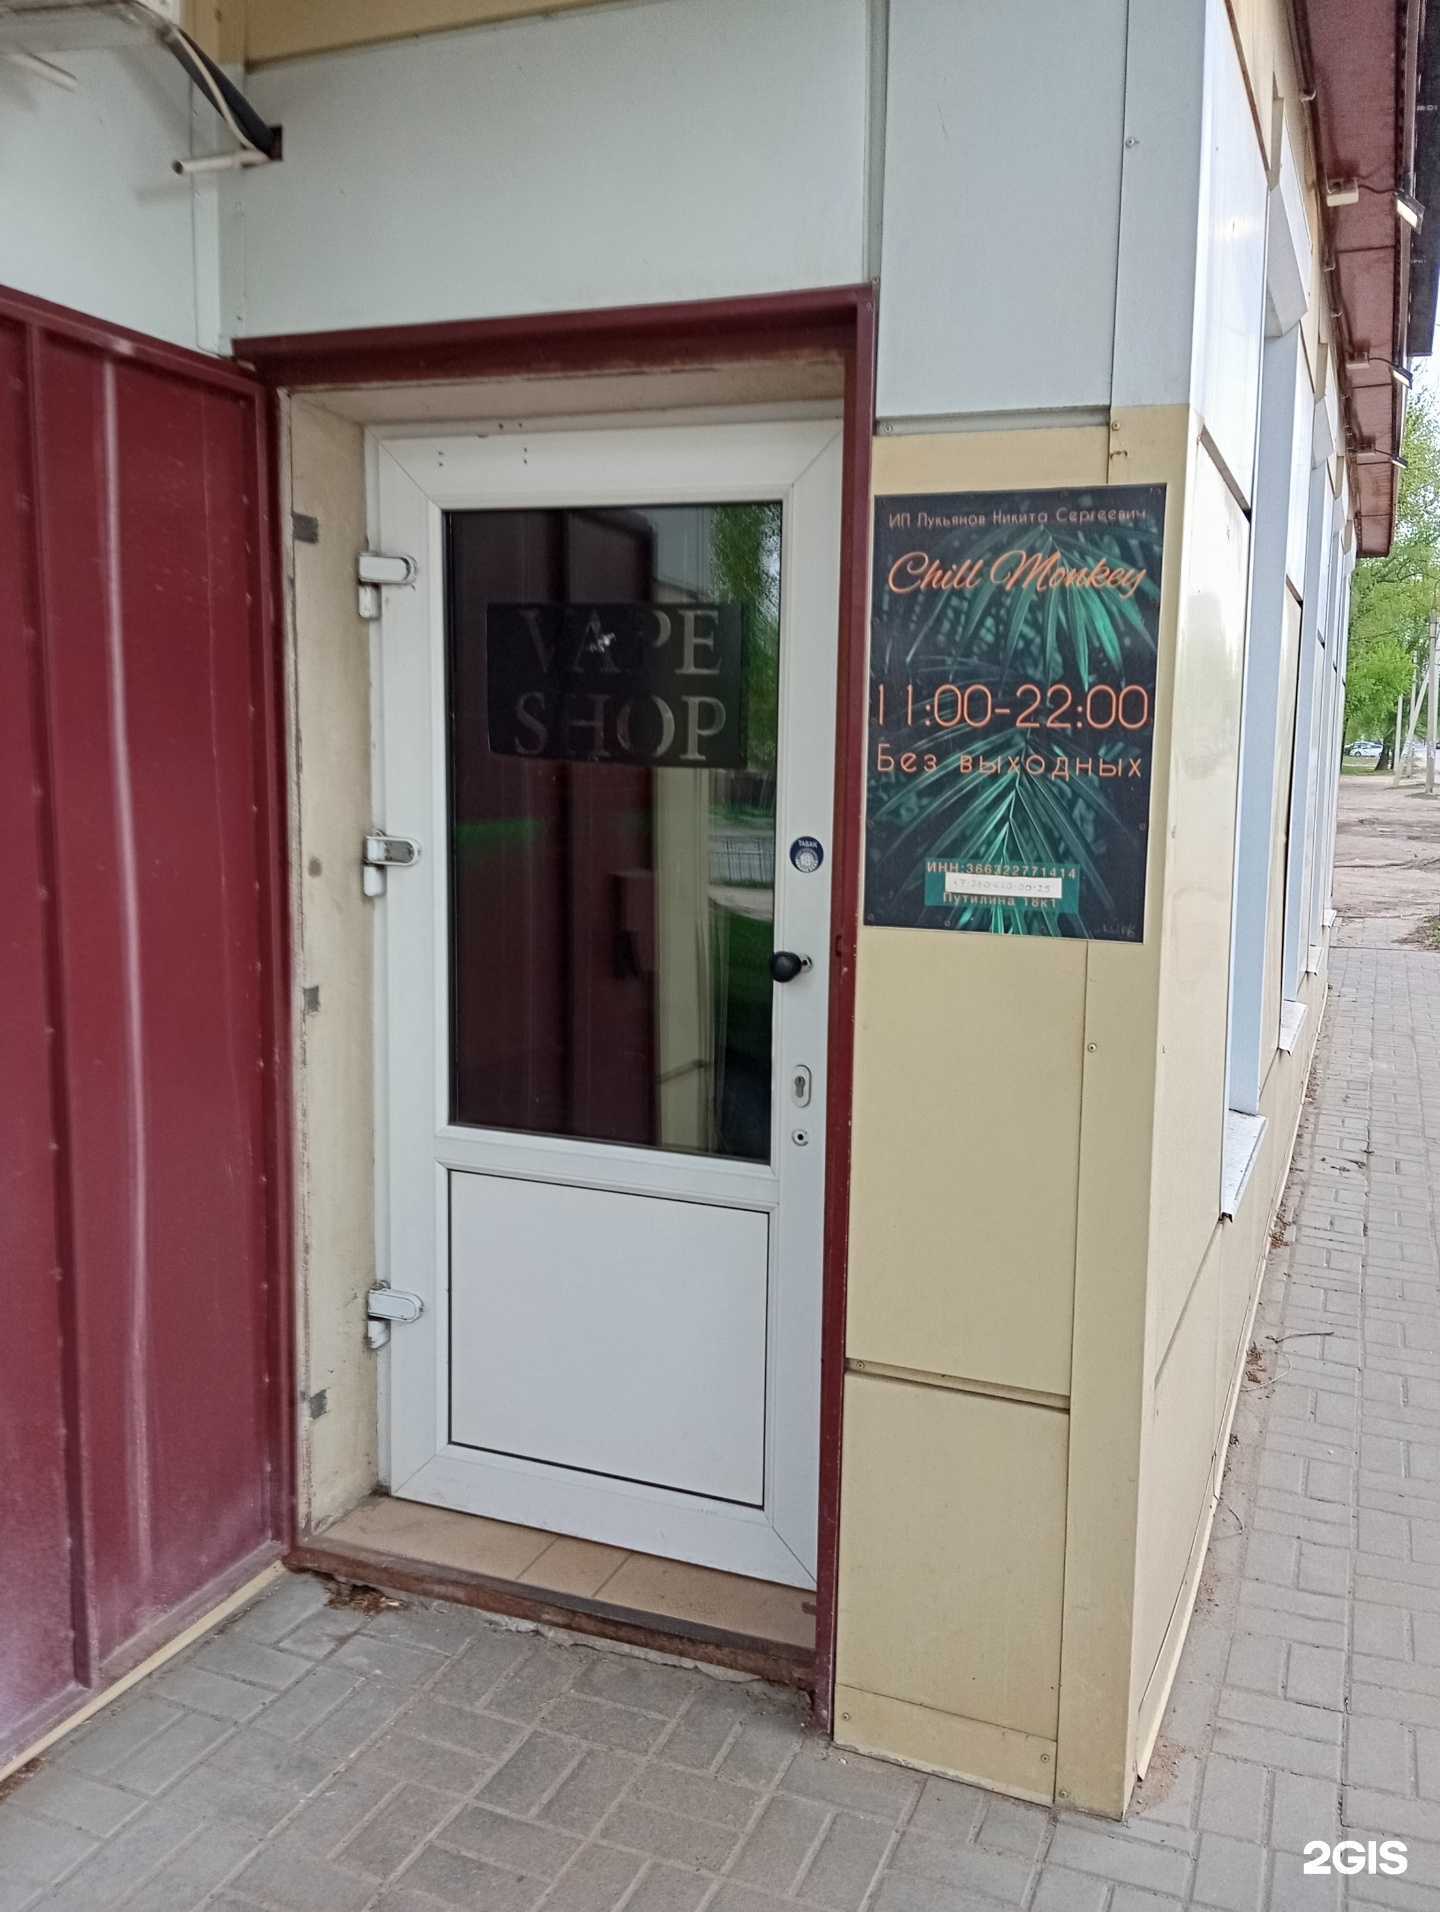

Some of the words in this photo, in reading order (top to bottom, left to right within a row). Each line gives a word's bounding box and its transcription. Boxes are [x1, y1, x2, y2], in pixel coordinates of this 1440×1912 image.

[889, 511, 911, 528] ИП
[917, 511, 986, 529] Лукьянов
[993, 509, 1048, 527] Никита
[1056, 506, 1147, 526] Сергеевич
[888, 551, 985, 594] Chill
[990, 549, 1148, 600] Monkey
[513, 608, 722, 675] VAPE
[513, 691, 727, 761] SHOP
[877, 683, 1150, 730] 11:00-22:00
[877, 742, 938, 774] Без
[960, 753, 1143, 781] выходных
[943, 892, 1016, 907] Путилина
